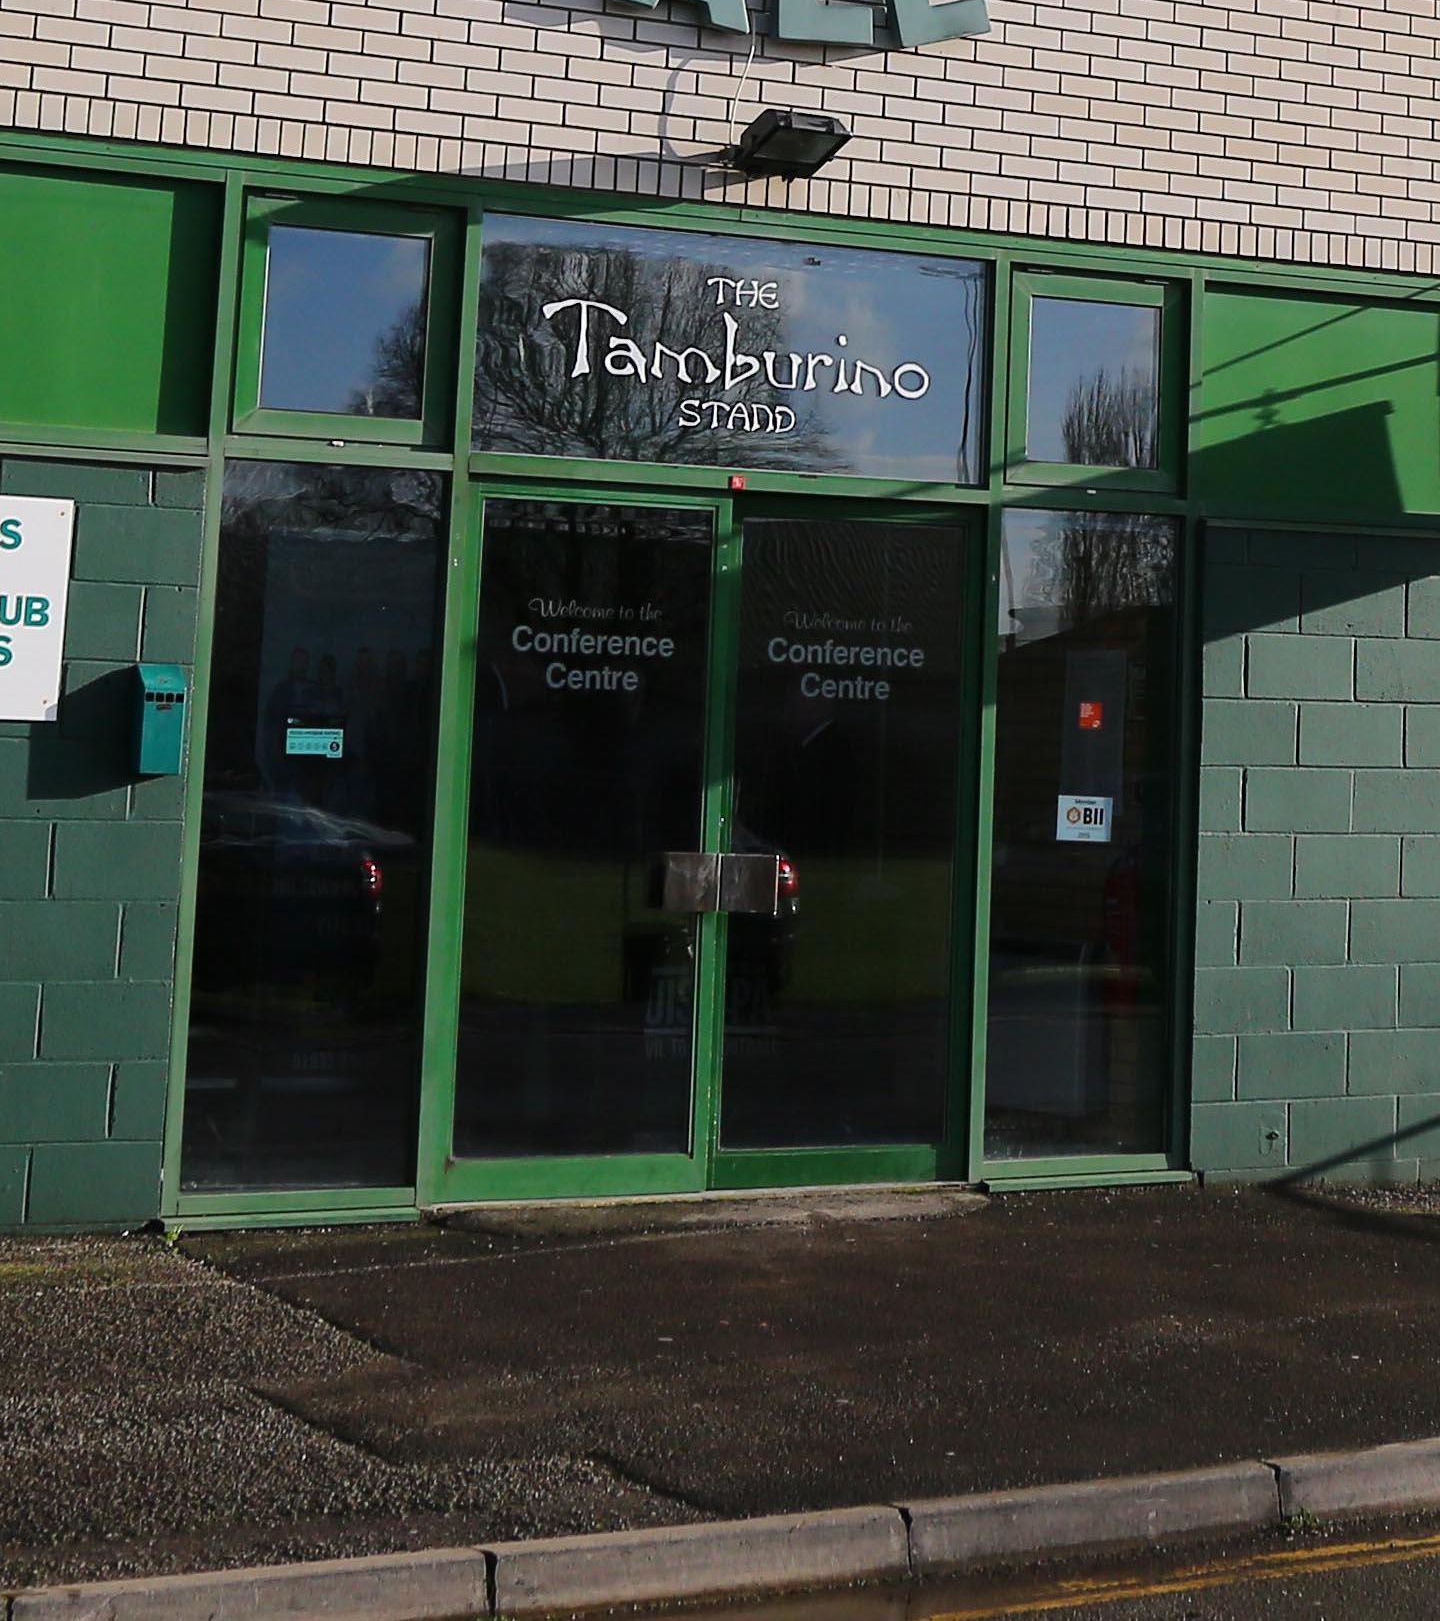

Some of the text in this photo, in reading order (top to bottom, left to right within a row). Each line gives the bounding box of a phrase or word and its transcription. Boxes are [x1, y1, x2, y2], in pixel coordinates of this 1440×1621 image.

[707, 277, 779, 309] THE
[542, 298, 932, 400] Tamburino
[679, 399, 797, 434] STAND
[527, 597, 663, 622] Welcome to the
[783, 610, 913, 635] Welcome to the
[511, 624, 675, 658] Conference
[767, 636, 925, 667] Conference
[545, 661, 640, 691] Centre
[800, 671, 891, 700] Centre
[1083, 807, 1104, 826] BII
